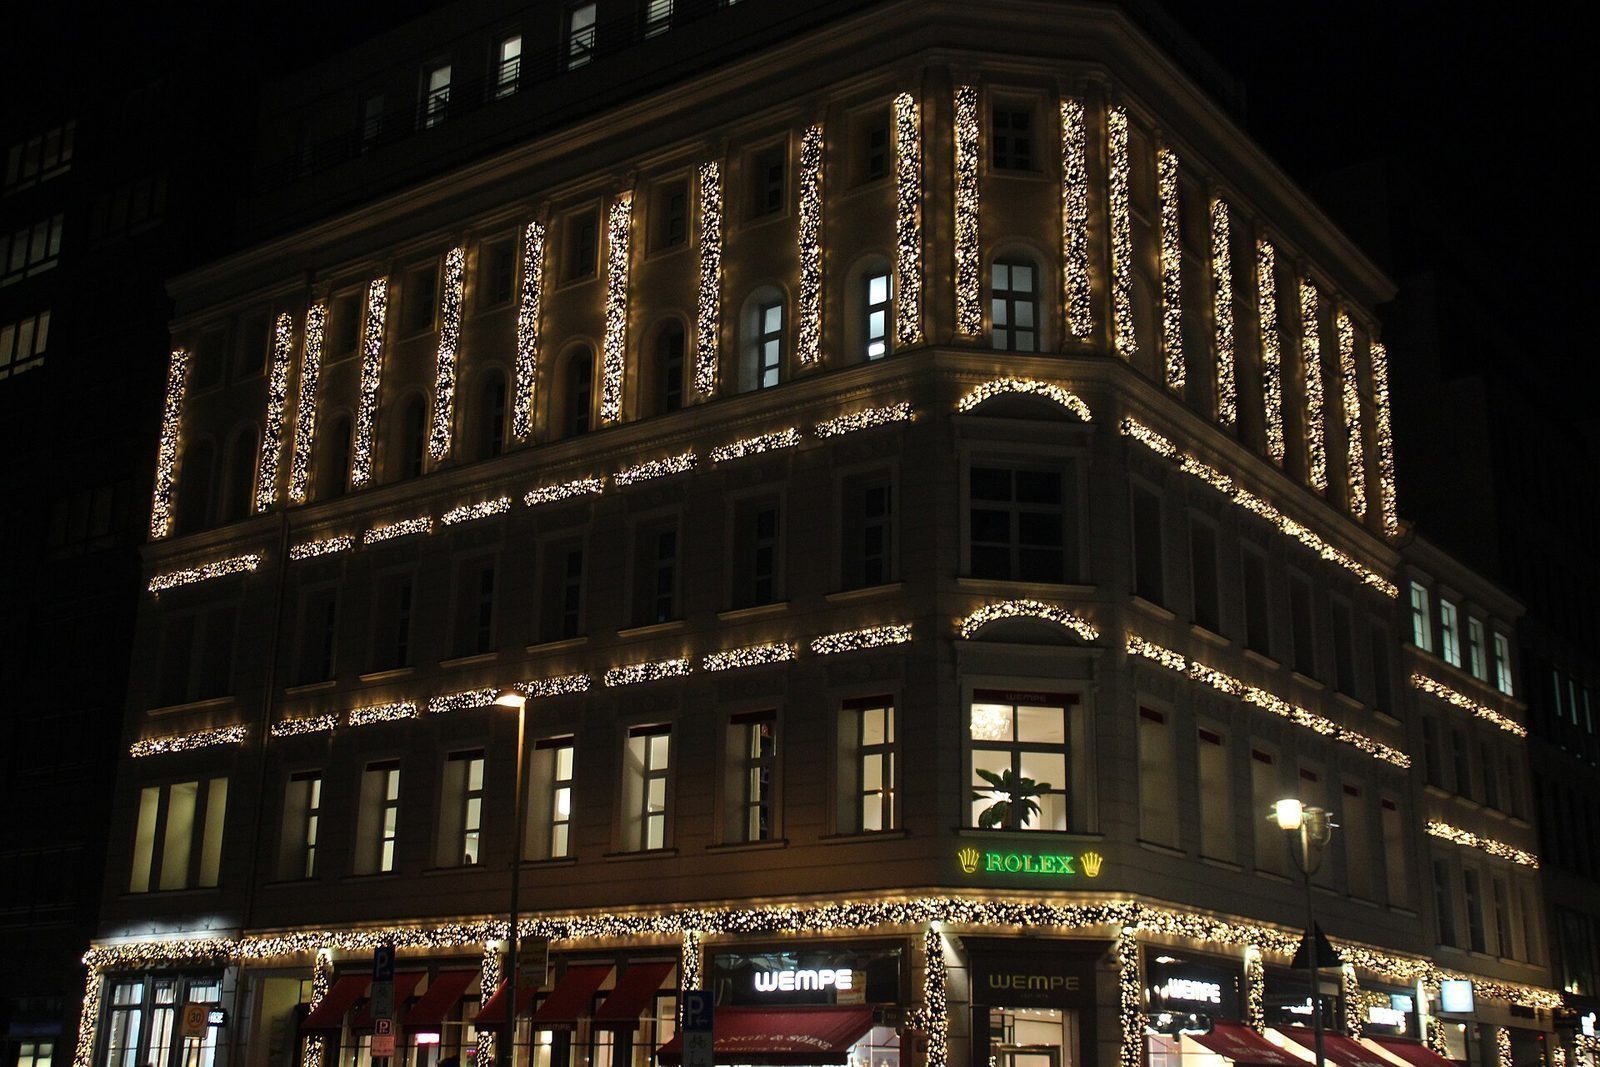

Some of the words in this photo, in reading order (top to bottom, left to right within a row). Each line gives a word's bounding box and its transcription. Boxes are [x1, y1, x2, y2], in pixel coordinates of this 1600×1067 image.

[986, 852, 1076, 874] ROLEX
[754, 968, 853, 992] WEMPE
[989, 974, 1080, 991] WEMPE
[191, 1011, 201, 1024] 30
[688, 995, 704, 1026] P
